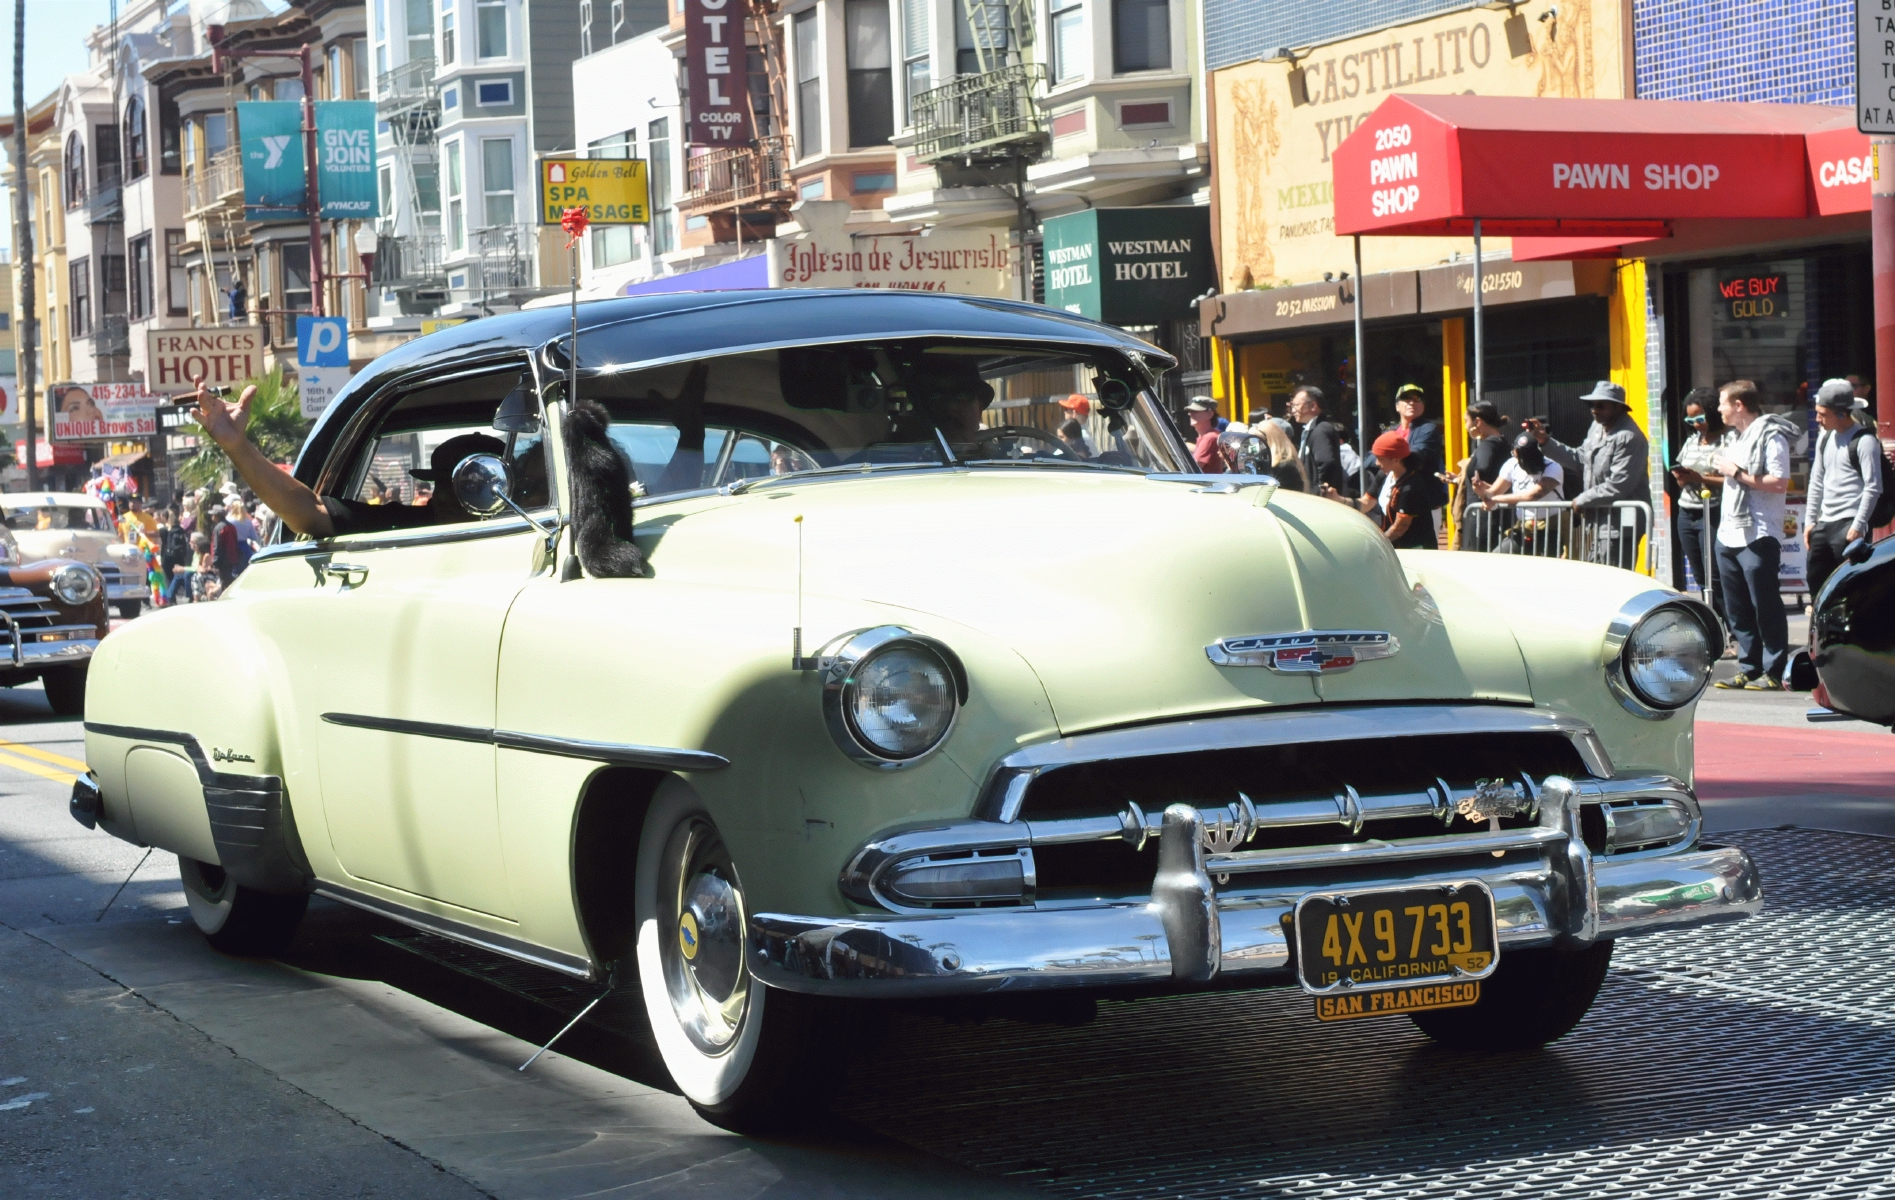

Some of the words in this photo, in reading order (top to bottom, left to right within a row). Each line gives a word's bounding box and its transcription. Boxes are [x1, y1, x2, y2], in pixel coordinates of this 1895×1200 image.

[1304, 22, 1491, 106] CASTILLITO
[700, 112, 742, 123] COLOR
[1864, 108, 1880, 124] AT
[324, 129, 370, 147] GIVE
[709, 126, 732, 140] TV
[1375, 124, 1411, 151] 2050
[250, 151, 264, 159] the
[325, 146, 370, 164] JOIN
[325, 164, 371, 172] VOLUNTEER
[571, 162, 609, 183] Golden
[613, 162, 640, 178] Bell
[1371, 152, 1418, 186] PAWN
[1553, 163, 1630, 189] PAWN
[1643, 163, 1720, 190] SHOP
[549, 186, 589, 201] SPA
[1371, 185, 1420, 218] SHOP
[327, 201, 371, 210] #YMCASF
[1048, 243, 1093, 265] WESTMAN
[1108, 239, 1192, 255] WESTMAN
[784, 241, 863, 282] Iglesia
[868, 239, 893, 271] de
[900, 234, 1008, 271] Jesucristo
[1051, 264, 1092, 290] HOTEL
[1115, 261, 1188, 281] HOTEL
[1719, 279, 1746, 298] WE
[1302, 295, 1337, 313] MISSION
[1732, 298, 1774, 318] GOLD
[157, 334, 254, 353] FRANCES
[158, 354, 257, 385] HOTEL
[56, 422, 97, 438] UNIQUE
[99, 420, 135, 435] Brows
[1466, 956, 1485, 969] 52
[1321, 971, 1338, 985] 19
[1351, 961, 1448, 982] CALIFORNIA
[1323, 995, 1363, 1016] SAN
[1370, 983, 1475, 1010] FRANCISCO
